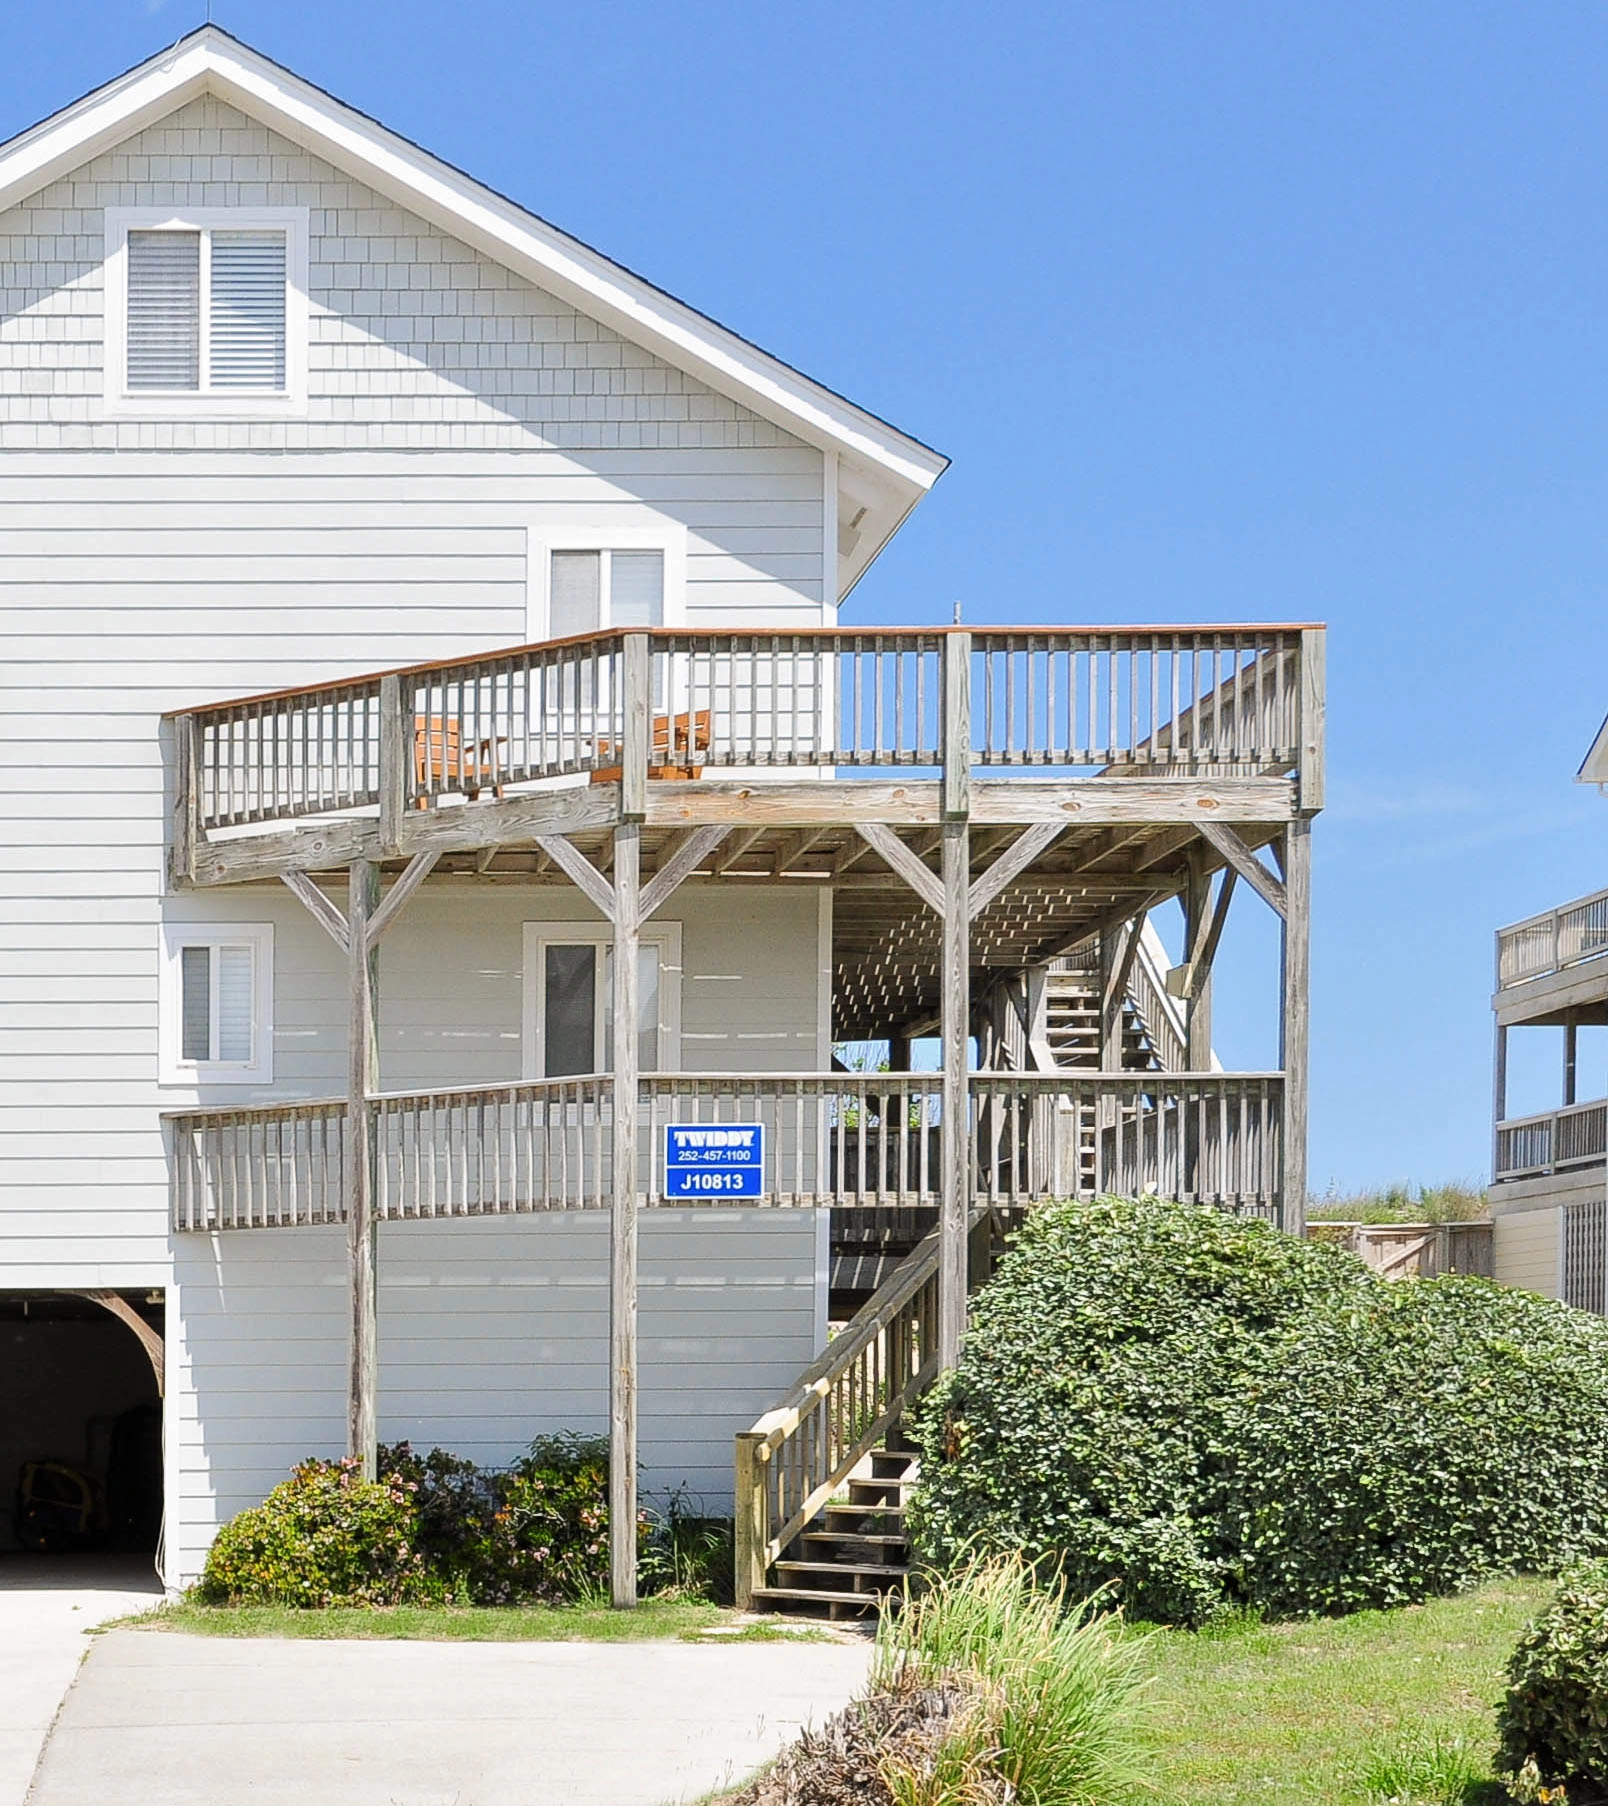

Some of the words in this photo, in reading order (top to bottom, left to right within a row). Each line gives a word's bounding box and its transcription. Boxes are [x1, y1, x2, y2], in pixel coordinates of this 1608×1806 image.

[674, 1131, 754, 1147] TWIDDY
[678, 1151, 750, 1161] 252-457-1100
[681, 1174, 743, 1189] J10813
